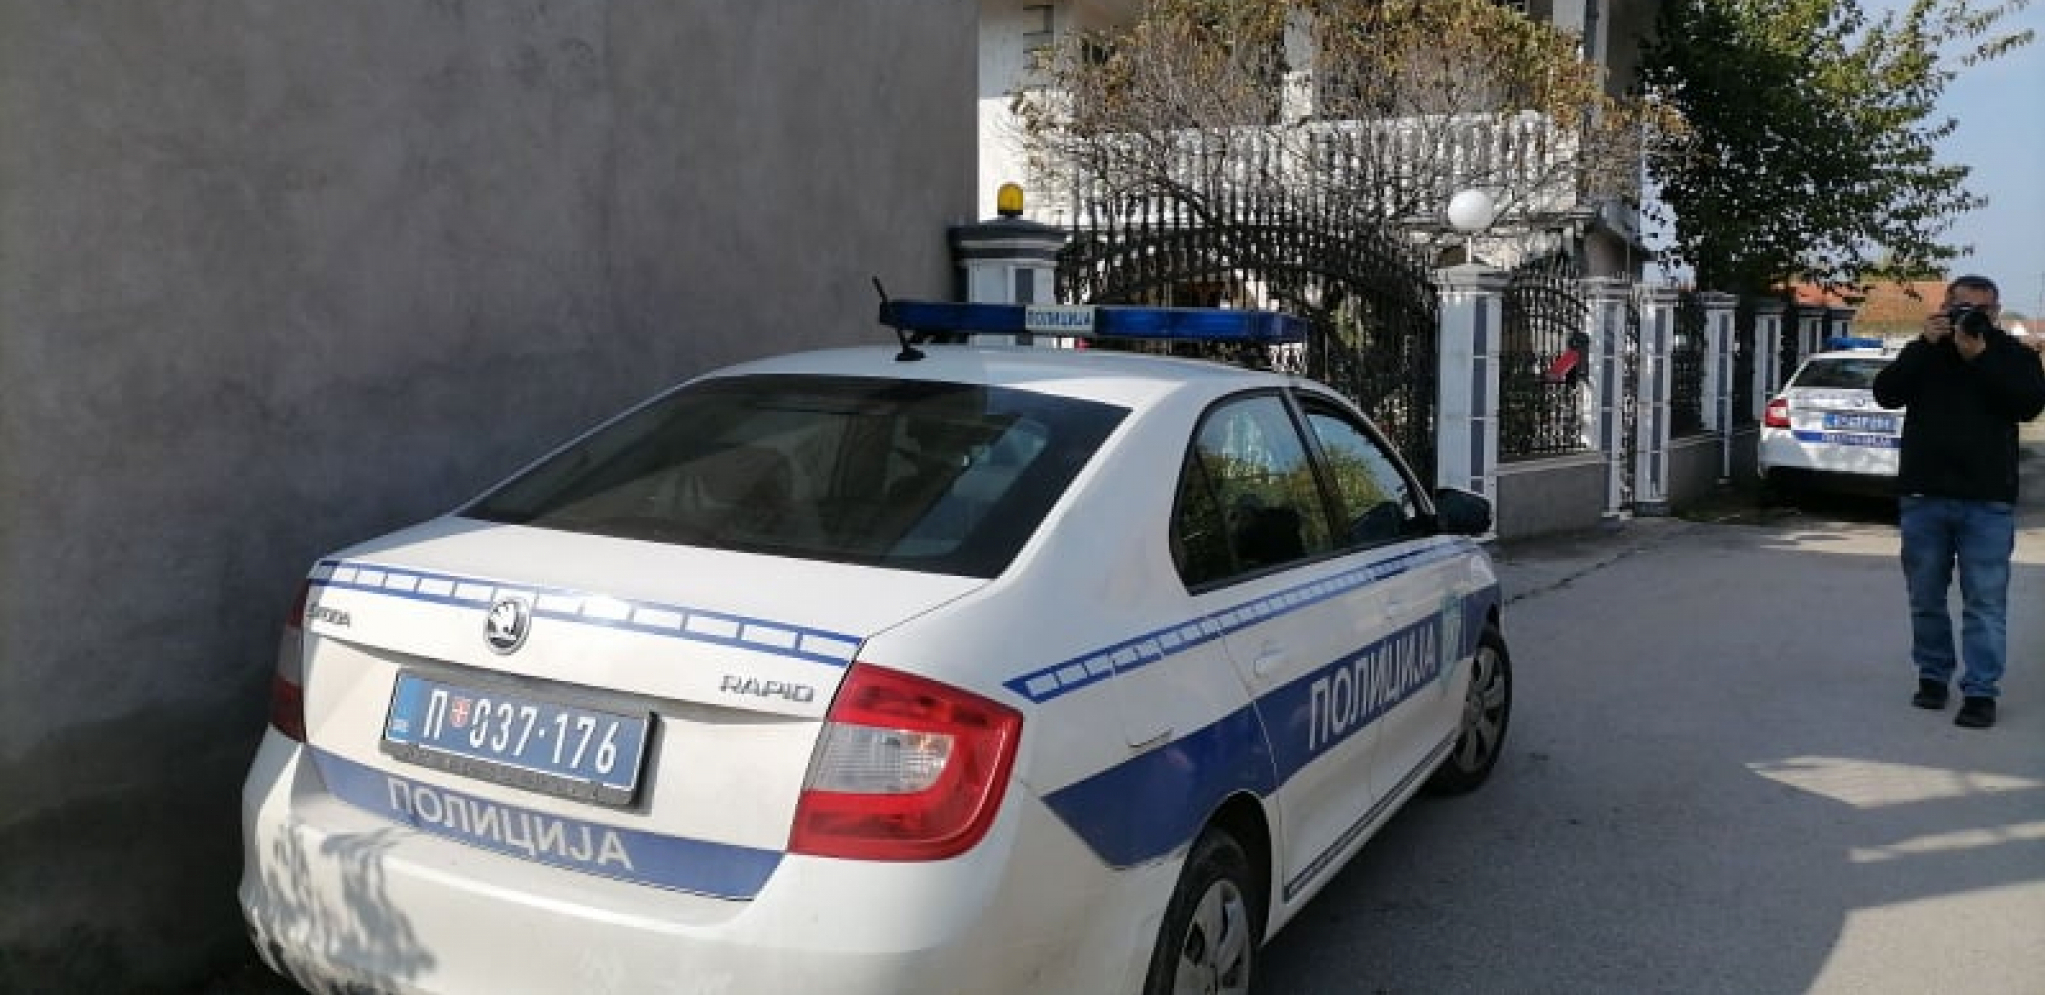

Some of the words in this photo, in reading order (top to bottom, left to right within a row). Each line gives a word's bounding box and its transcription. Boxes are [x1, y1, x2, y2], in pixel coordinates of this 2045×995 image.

[1027, 310, 1091, 327] ПОЛИЦИЈА
[720, 675, 814, 702] RAPID
[1309, 621, 1436, 751] ПОЛИЦИЈА
[387, 778, 635, 871] ПОЛИЦИЈА
